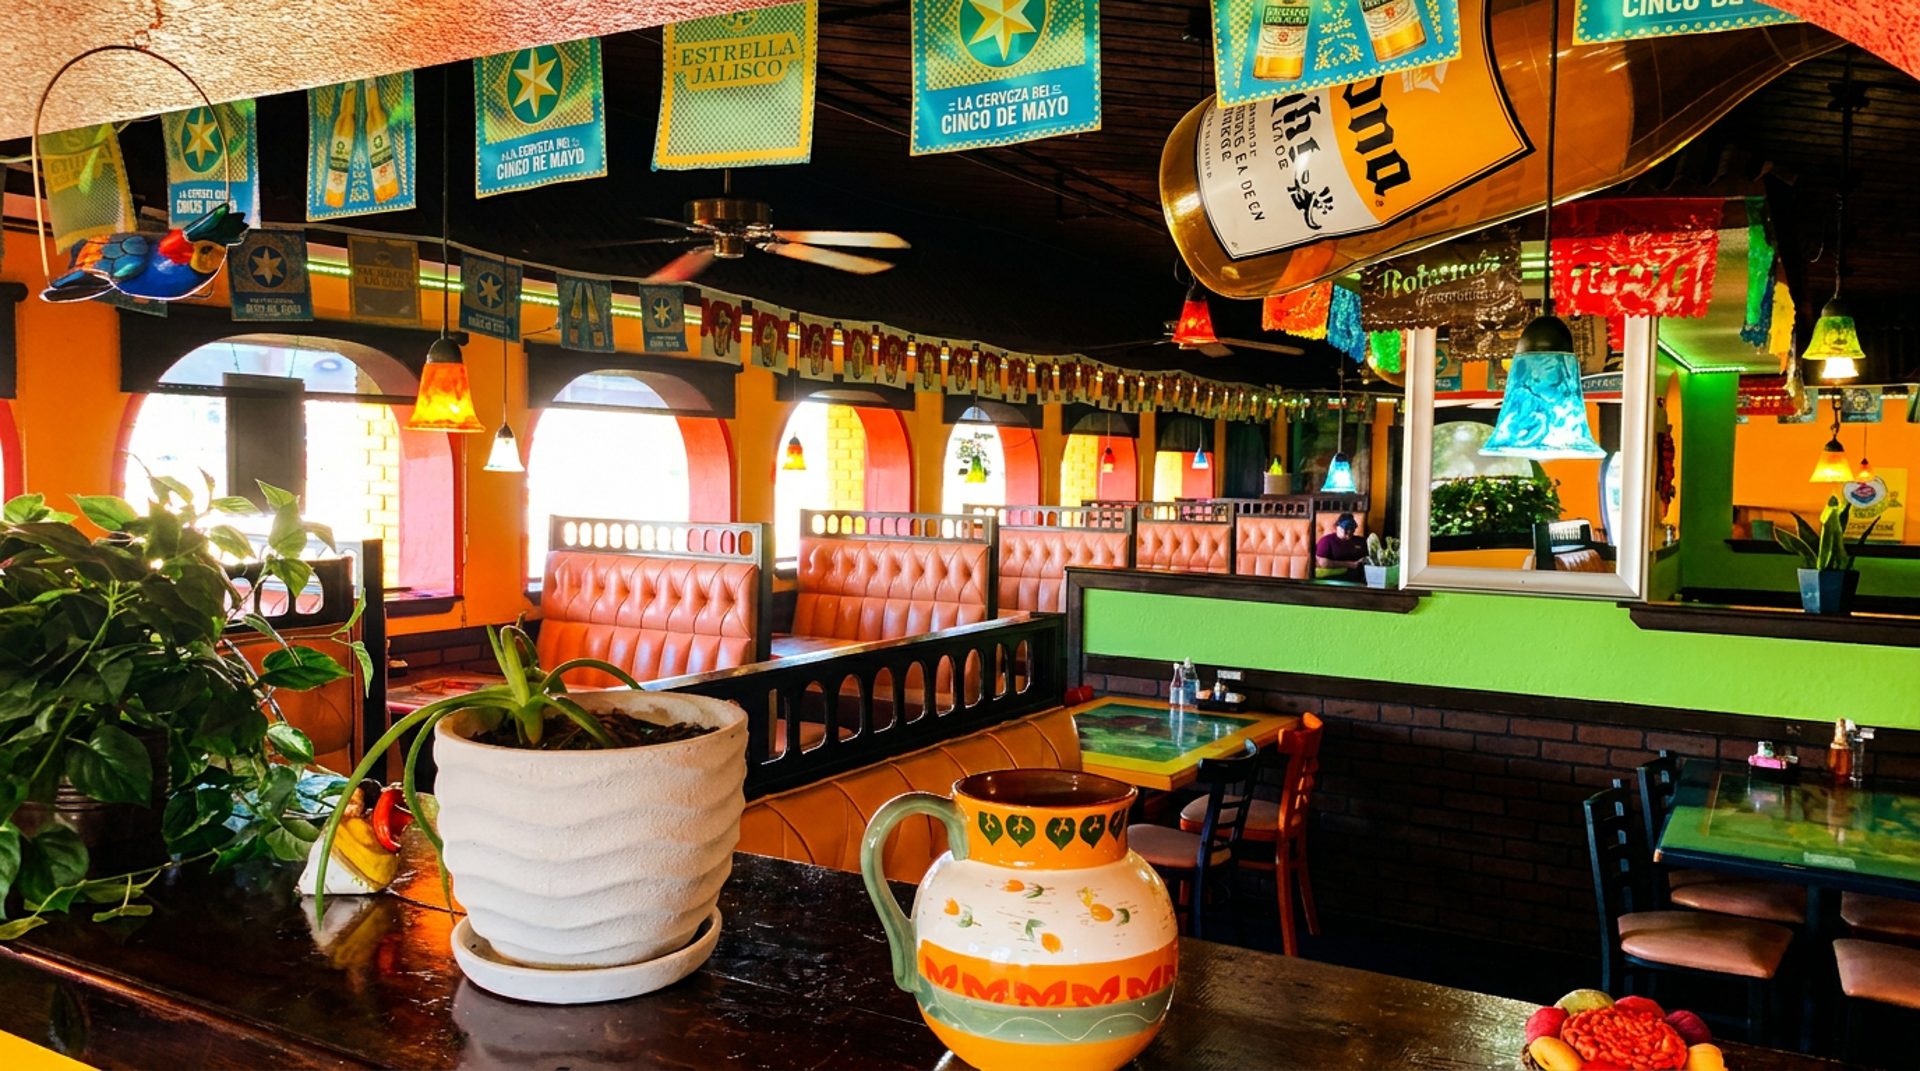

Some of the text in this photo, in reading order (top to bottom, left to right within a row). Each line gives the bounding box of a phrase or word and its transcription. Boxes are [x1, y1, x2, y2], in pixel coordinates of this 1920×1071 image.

[681, 37, 796, 66] ESTRELLA
[691, 59, 782, 84] JALISCO
[941, 95, 1069, 134] CINCO DE MAYO
